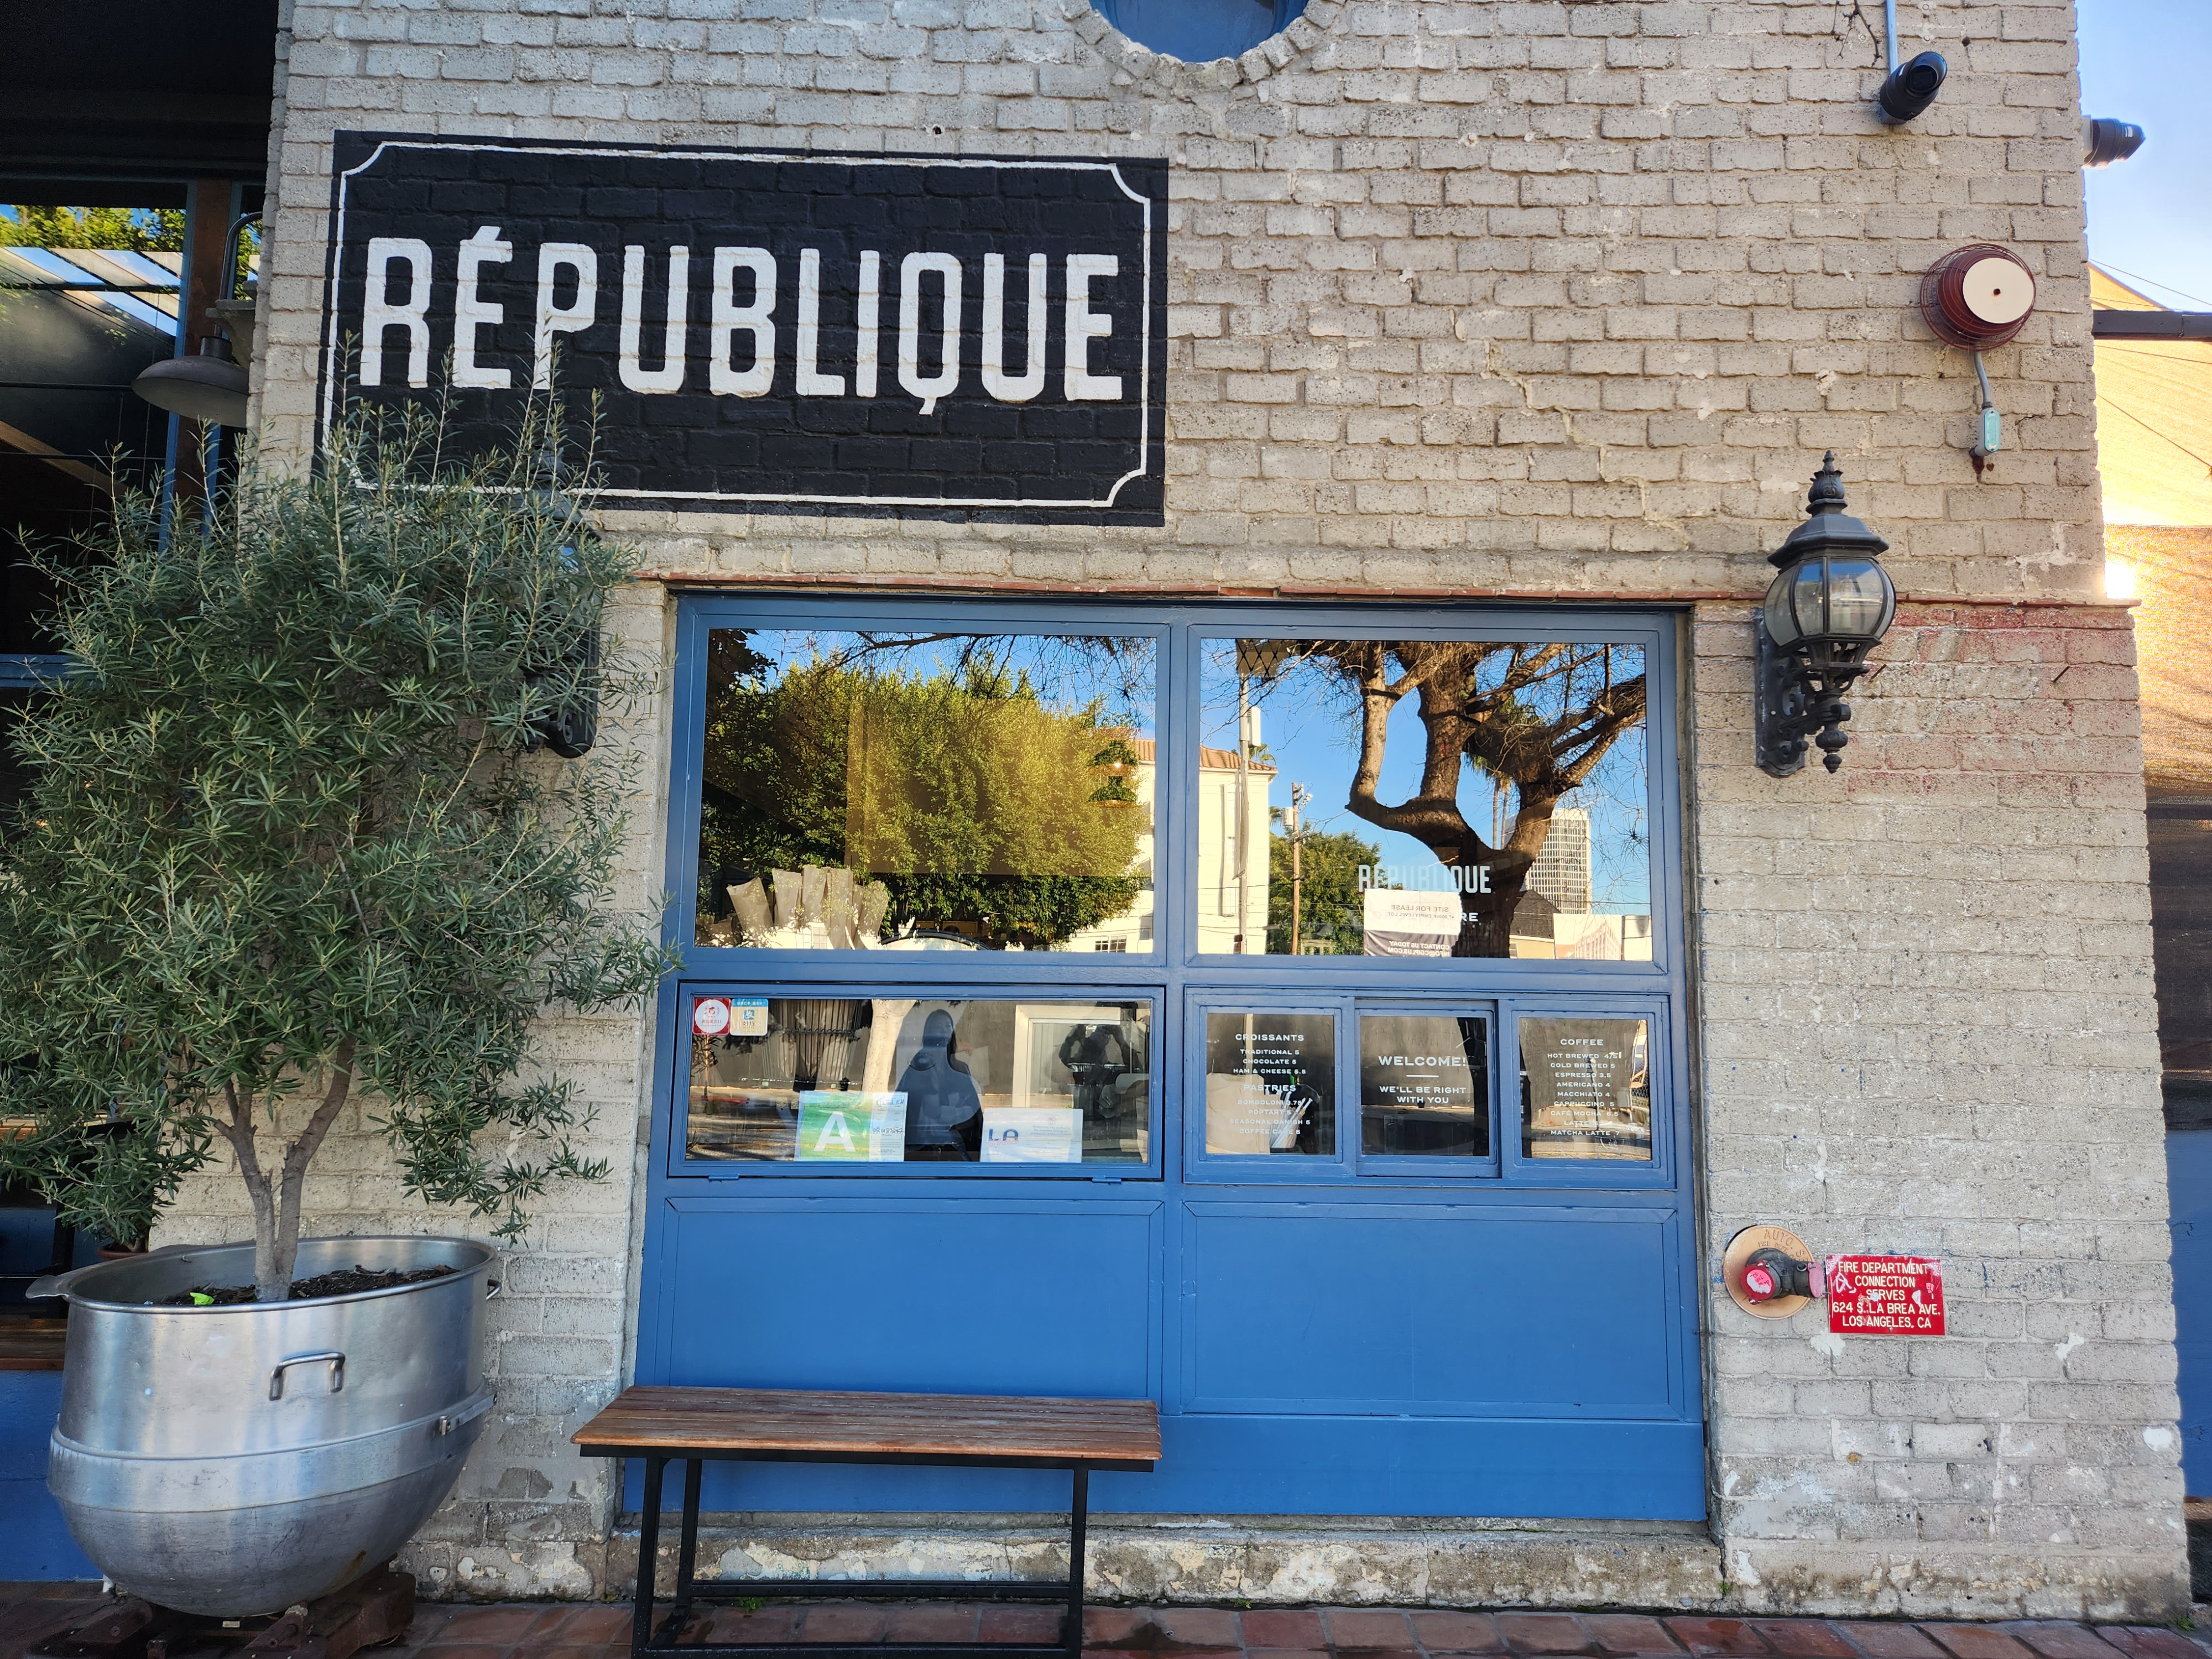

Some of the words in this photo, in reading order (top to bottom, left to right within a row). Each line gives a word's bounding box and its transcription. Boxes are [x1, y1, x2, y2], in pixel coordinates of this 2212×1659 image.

[359, 225, 1124, 415] RÉPUBLIQUE
[1378, 1056, 1466, 1067] WELCOME!
[813, 1111, 856, 1152] A
[988, 1128, 1019, 1142] LA
[1838, 1261, 1859, 1273] FIRE
[1862, 1262, 1928, 1274] DEPARTMENT
[1855, 1275, 1916, 1287] CONNECTION
[1833, 1302, 1853, 1313] 624
[1869, 1302, 1884, 1313] LA
[1887, 1303, 1916, 1314] BREA
[1919, 1303, 1940, 1315] AVE.
[1842, 1315, 1863, 1327] LOS
[1917, 1317, 1932, 1328] CA
